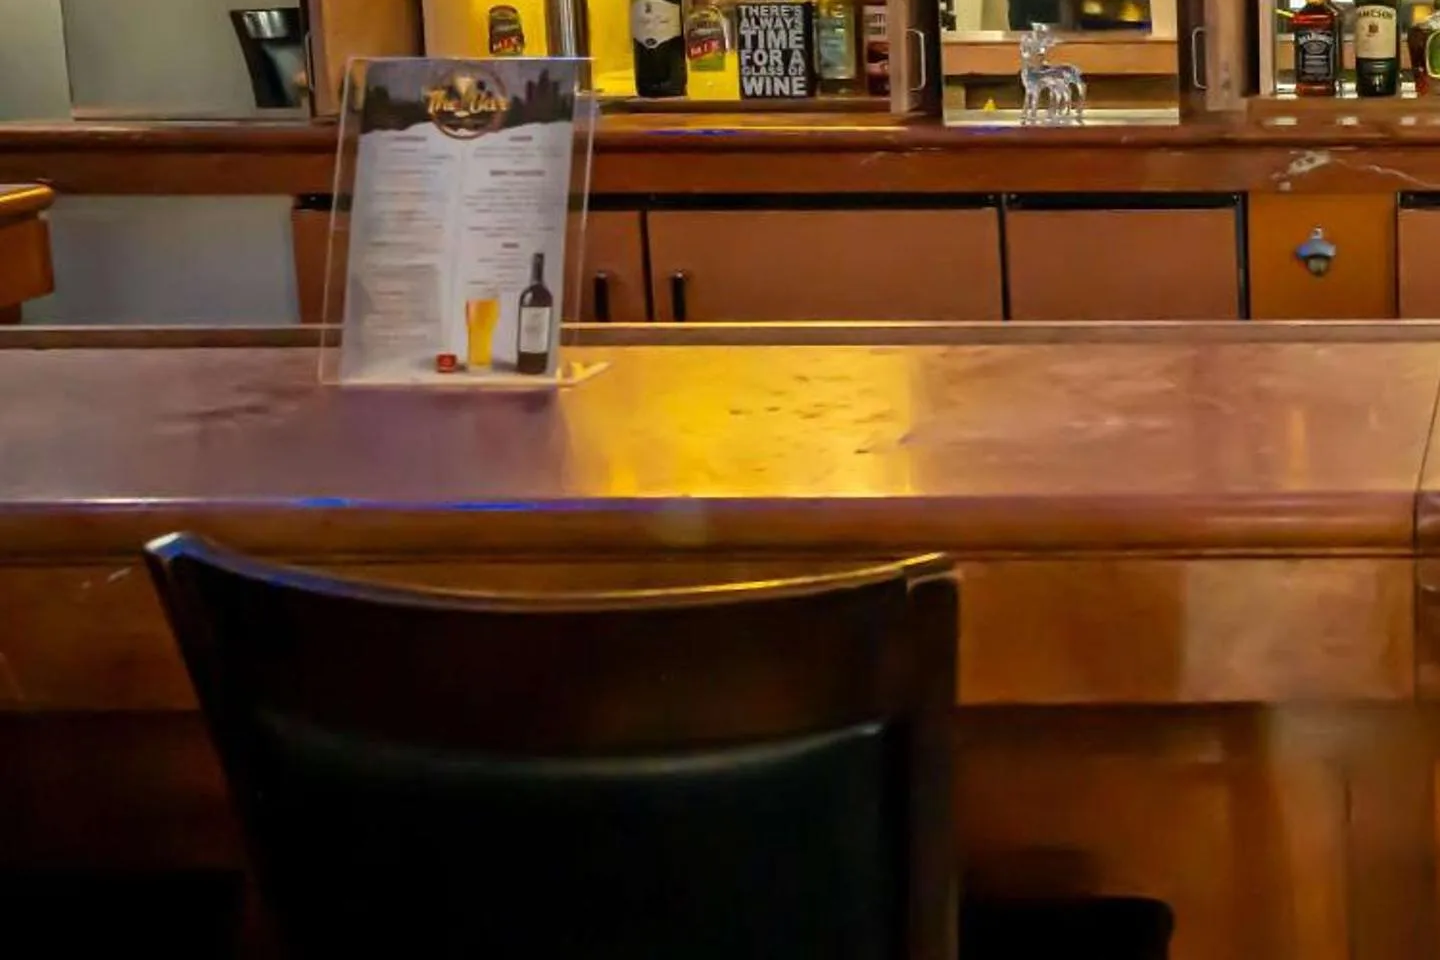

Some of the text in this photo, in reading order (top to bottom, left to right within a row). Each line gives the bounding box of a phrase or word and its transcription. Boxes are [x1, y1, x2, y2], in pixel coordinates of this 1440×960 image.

[740, 5, 804, 17] THERE'S
[740, 17, 804, 30] ALWAYS
[740, 30, 805, 49] TIME
[741, 49, 805, 66] FOR A
[742, 67, 805, 76] GLASS OF
[742, 76, 807, 96] WINE
